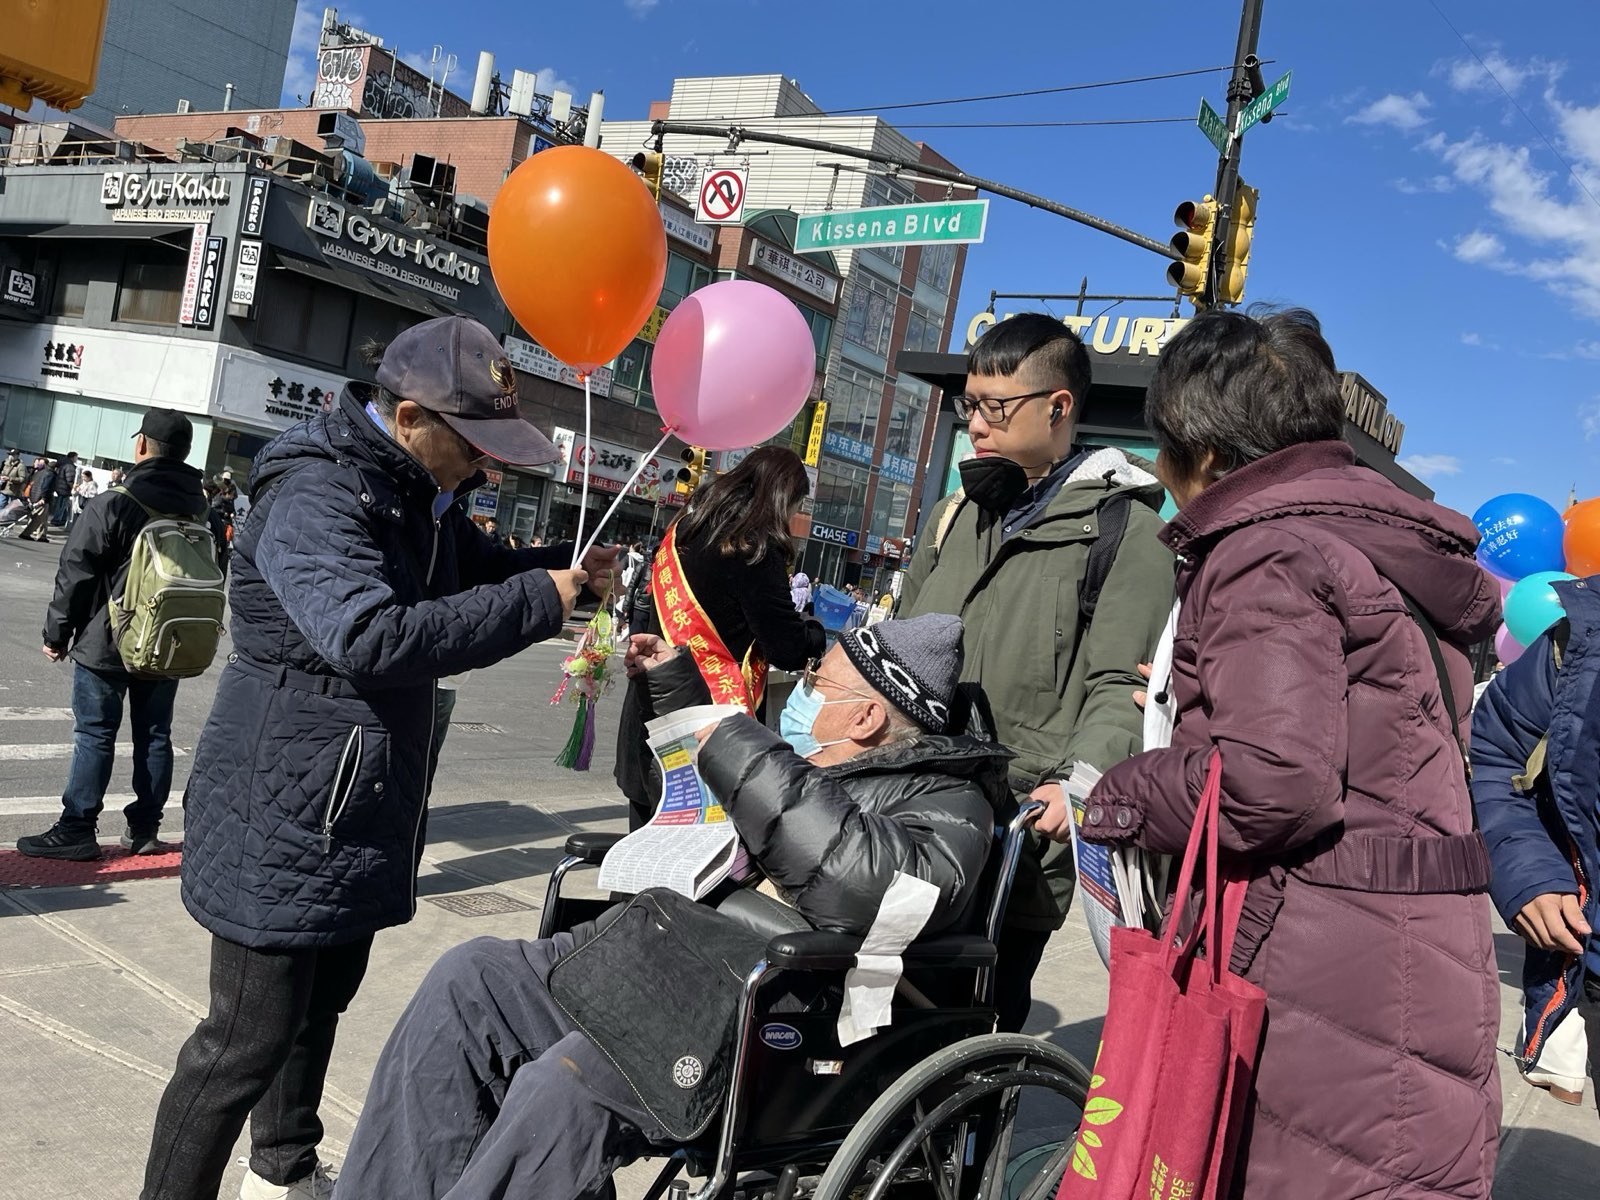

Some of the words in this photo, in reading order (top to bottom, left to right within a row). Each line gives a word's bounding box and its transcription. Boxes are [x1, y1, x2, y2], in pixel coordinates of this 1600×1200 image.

[1240, 93, 1273, 132] Kissena
[124, 173, 226, 205] Gyu-Kaku
[248, 187, 263, 223] PARK
[113, 209, 148, 219] JAPANESE
[148, 209, 164, 219] BBQ
[165, 210, 213, 220] RESTAURANT
[811, 220, 897, 242] Kissena
[904, 212, 962, 235] Blvd
[347, 215, 481, 285] Gyu-Kaku
[200, 251, 217, 307] PARK
[322, 241, 376, 269] JAPANESE
[377, 260, 399, 278] BBQ
[400, 270, 460, 299] RESTAURANT
[804, 269, 826, 290] 公司
[233, 290, 253, 301] BBQ
[967, 312, 1191, 356] CTUR
[494, 394, 512, 411] END
[512, 391, 519, 406] O
[1340, 373, 1405, 455] PAVILION
[812, 524, 848, 543] CHASE
